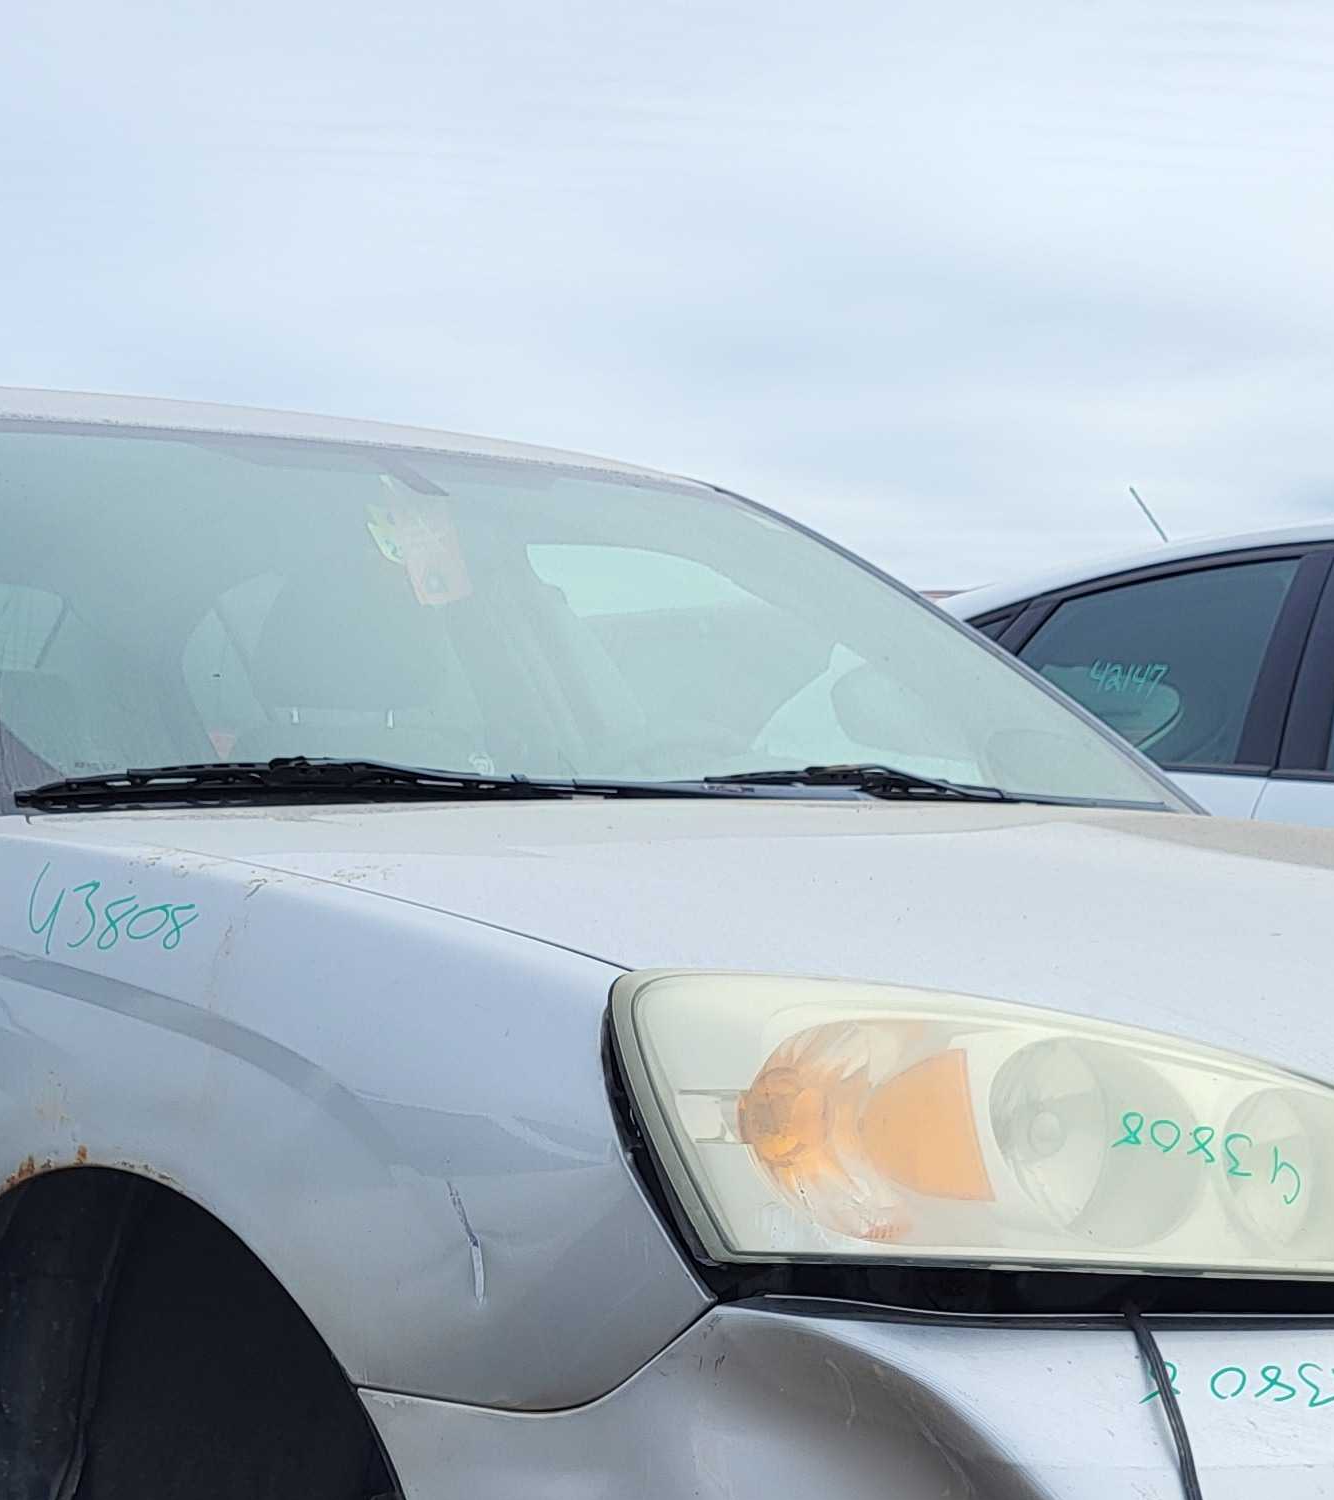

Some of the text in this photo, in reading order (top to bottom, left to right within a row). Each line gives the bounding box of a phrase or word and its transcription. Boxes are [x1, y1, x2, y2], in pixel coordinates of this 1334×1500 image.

[1090, 659, 1169, 697] 42147
[29, 861, 199, 955] 43808
[1111, 1112, 1301, 1205] 43808
